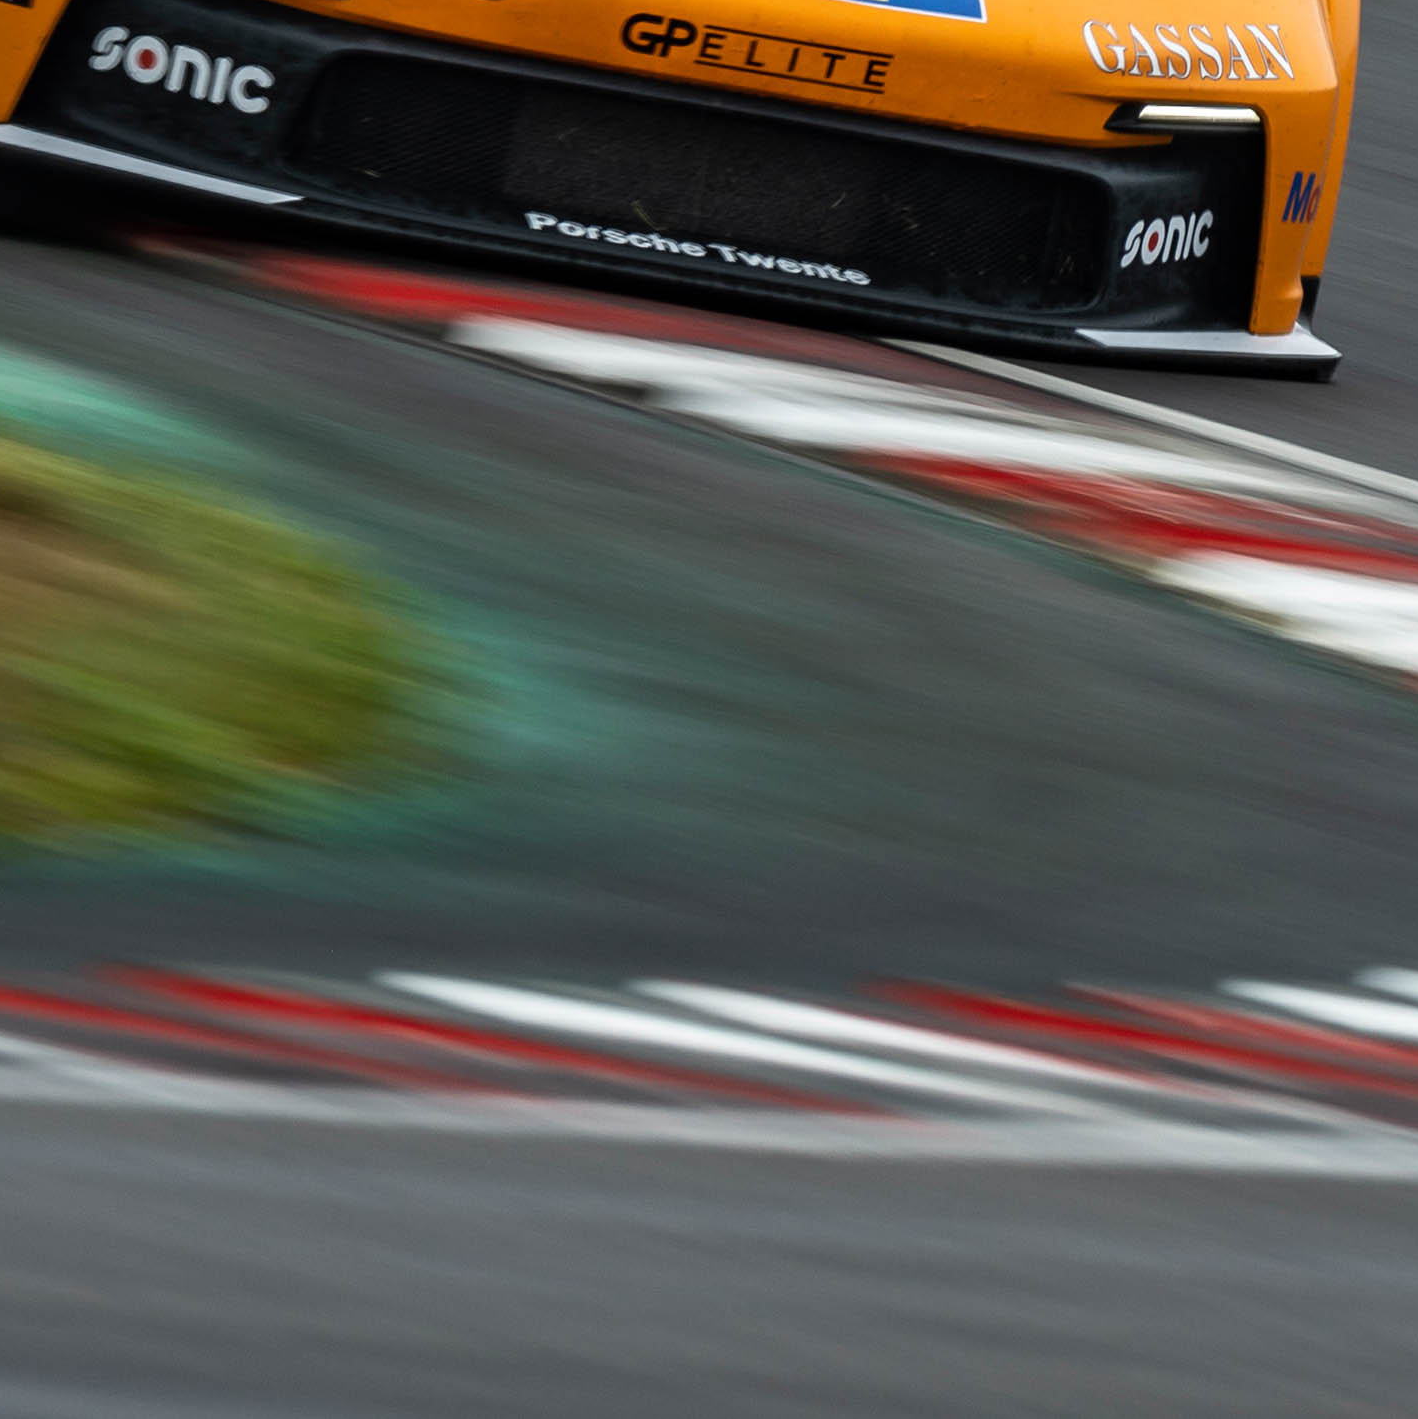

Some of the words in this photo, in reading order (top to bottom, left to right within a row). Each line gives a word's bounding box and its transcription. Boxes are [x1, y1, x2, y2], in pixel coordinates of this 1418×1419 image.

[1083, 19, 1295, 80] GASSAN
[525, 210, 706, 258] Porsche
[703, 242, 871, 286] Twente
